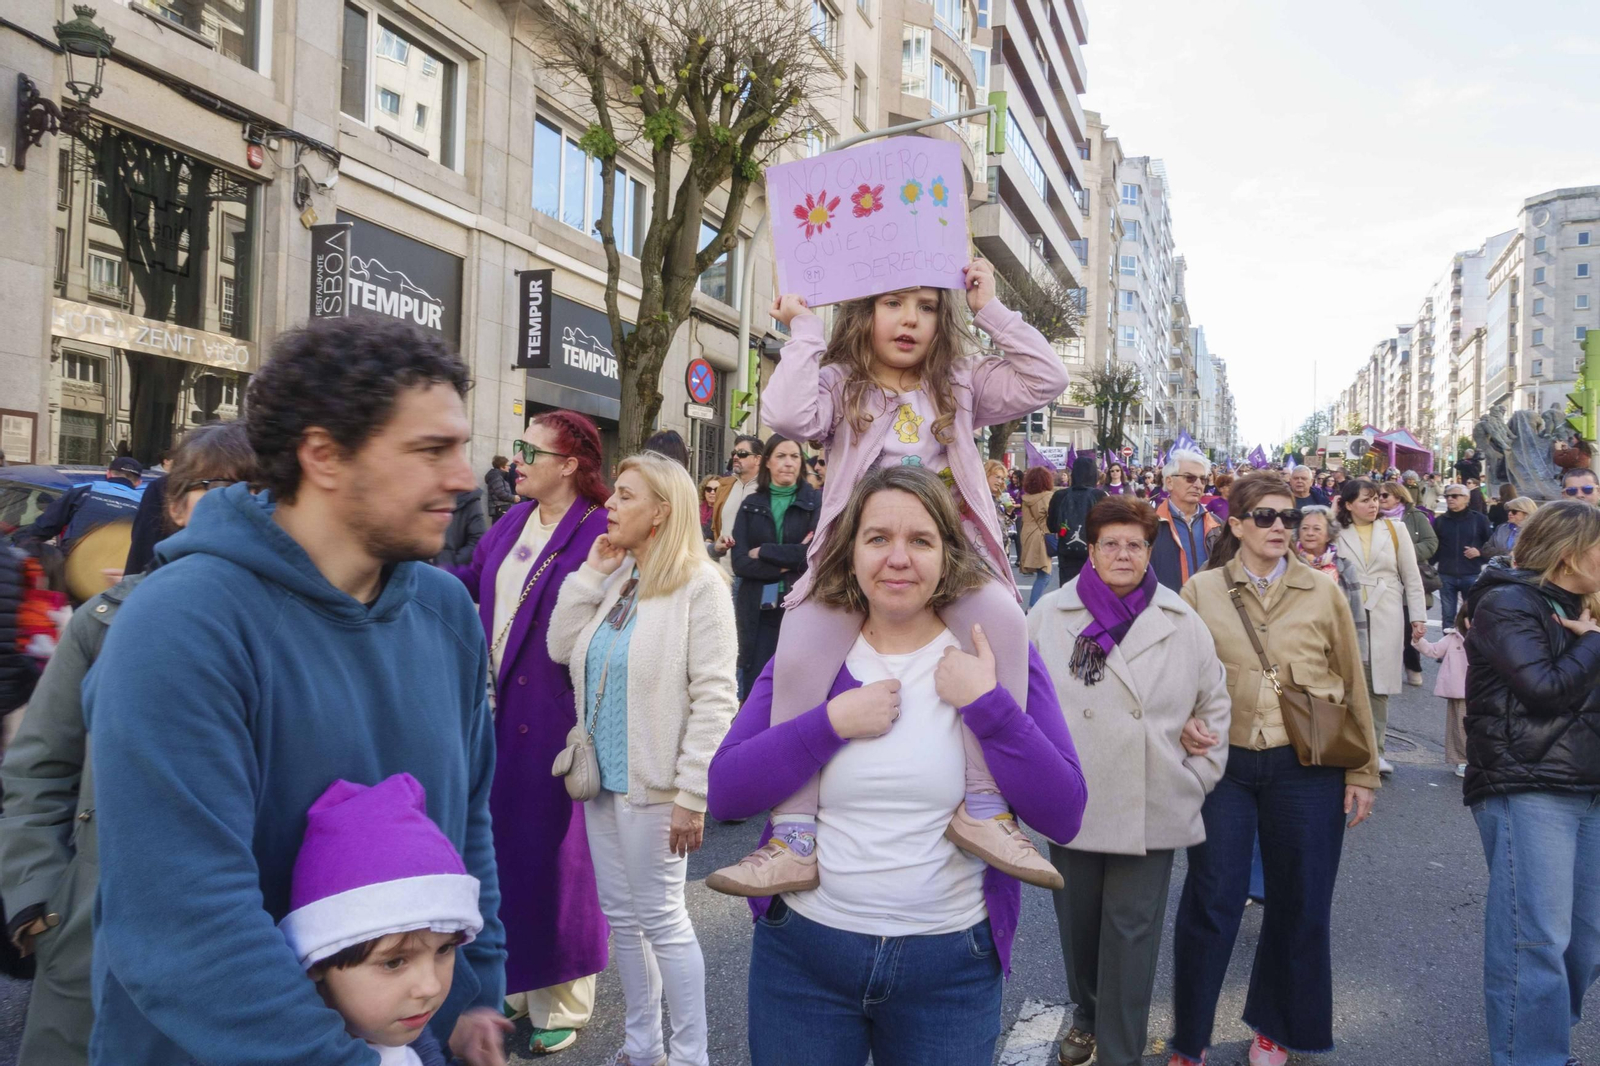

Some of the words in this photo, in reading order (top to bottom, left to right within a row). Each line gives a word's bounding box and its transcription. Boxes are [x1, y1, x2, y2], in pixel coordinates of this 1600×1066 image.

[787, 162, 827, 198] NO
[315, 254, 324, 316] RESTAURANTE
[323, 230, 345, 319] ISBOA
[806, 269, 822, 280] 8M
[850, 250, 958, 283] DERECHOS
[349, 277, 442, 331] TEMPUR
[527, 279, 543, 358] TEMPUR
[51, 306, 127, 341] HOTEL
[136, 325, 195, 355] ZENIT
[561, 343, 619, 380] TEMPUR
